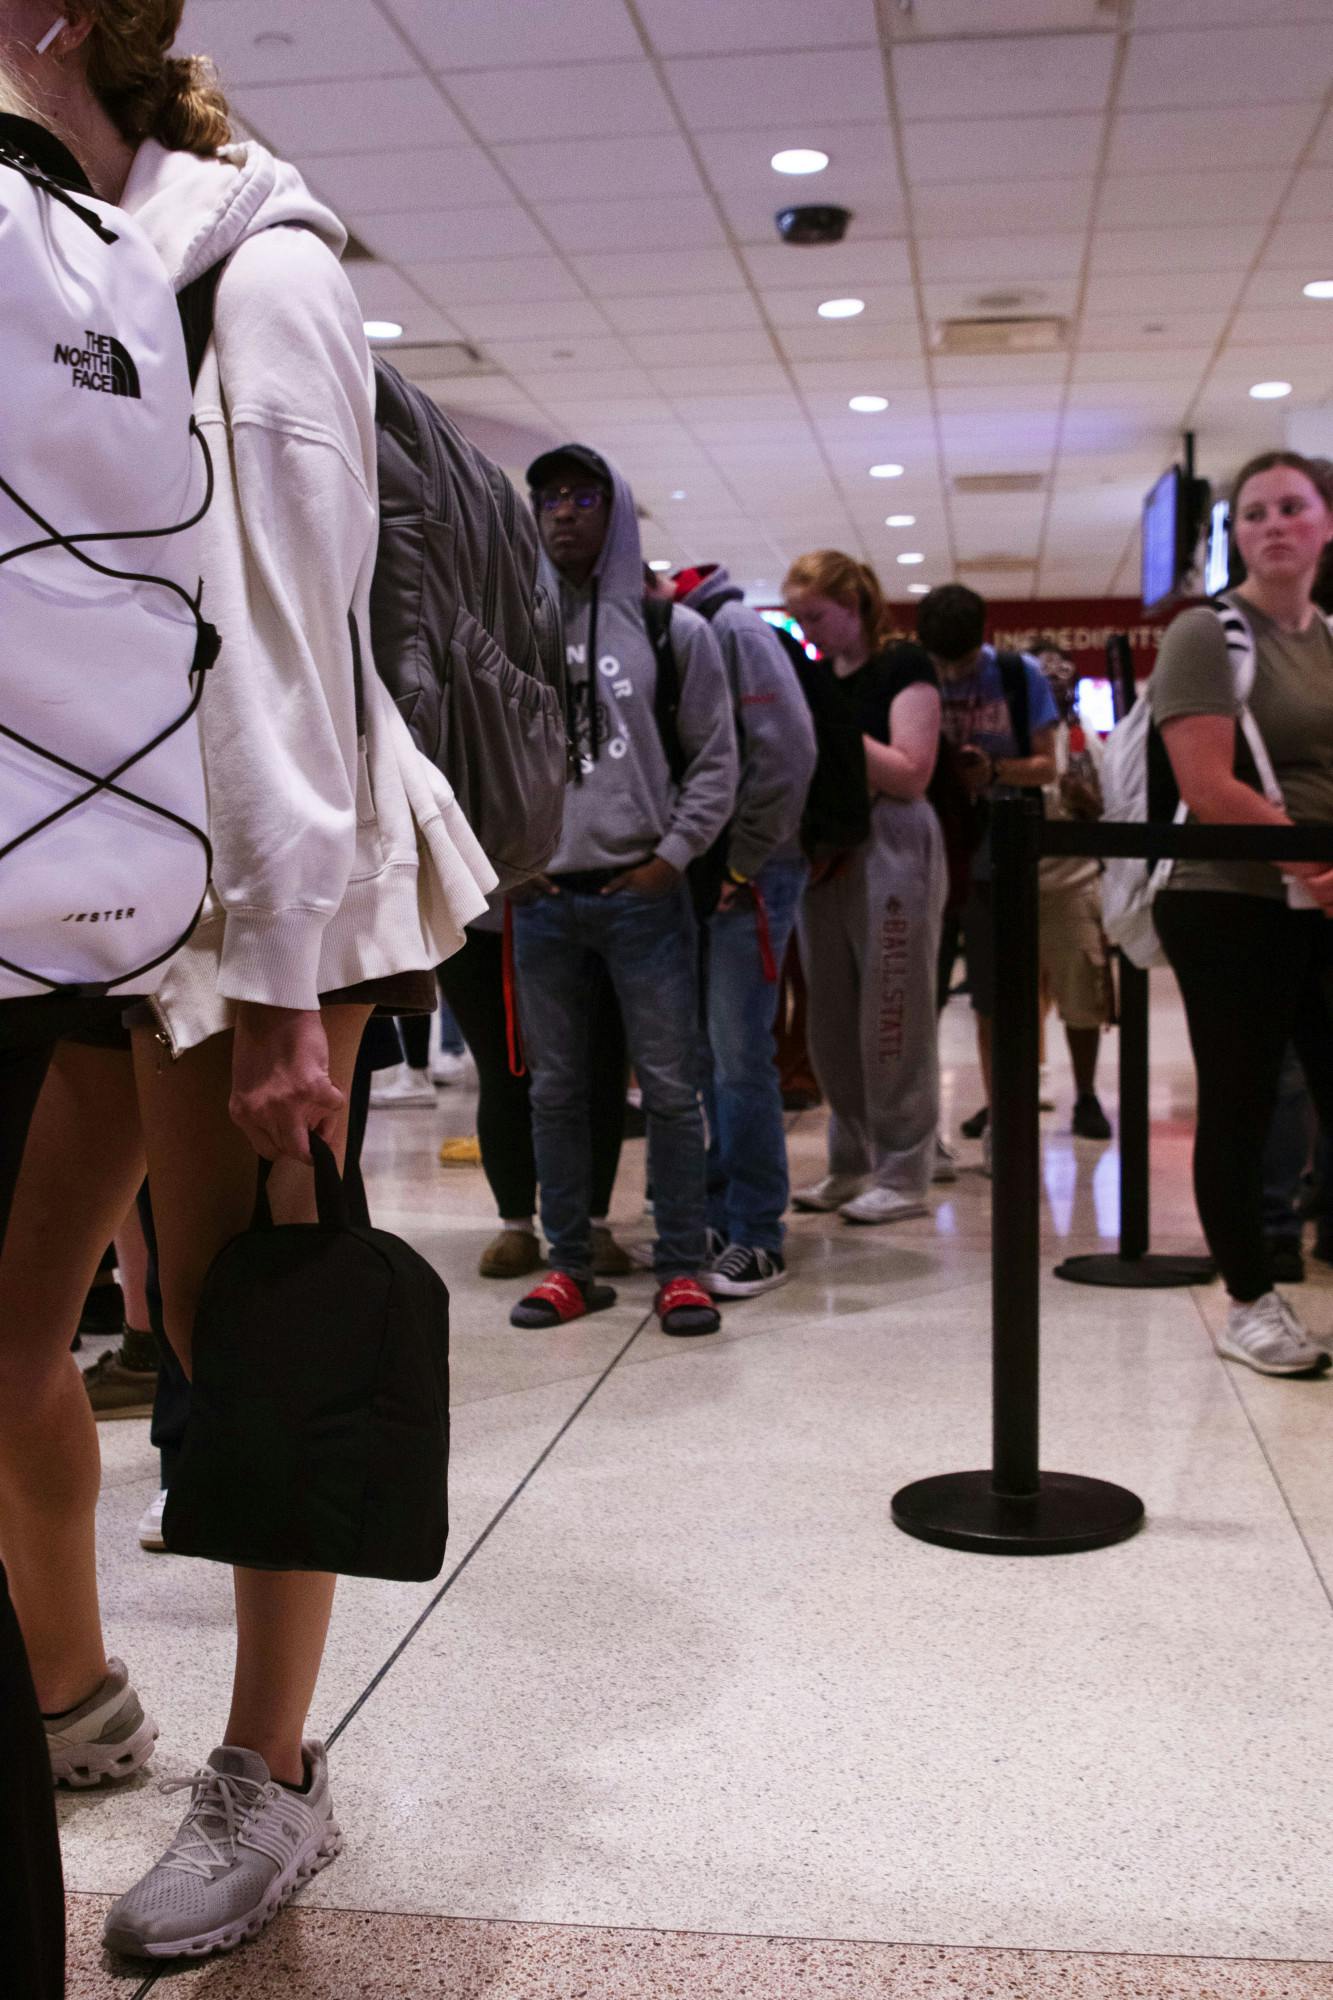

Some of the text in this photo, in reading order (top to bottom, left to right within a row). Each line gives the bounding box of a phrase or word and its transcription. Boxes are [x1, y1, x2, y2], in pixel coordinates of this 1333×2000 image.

[84, 330, 110, 354] THE
[53, 343, 111, 374] NORTH
[72, 368, 113, 393] FACE
[62, 907, 136, 922] JESTER
[882, 918, 908, 983] BALL
